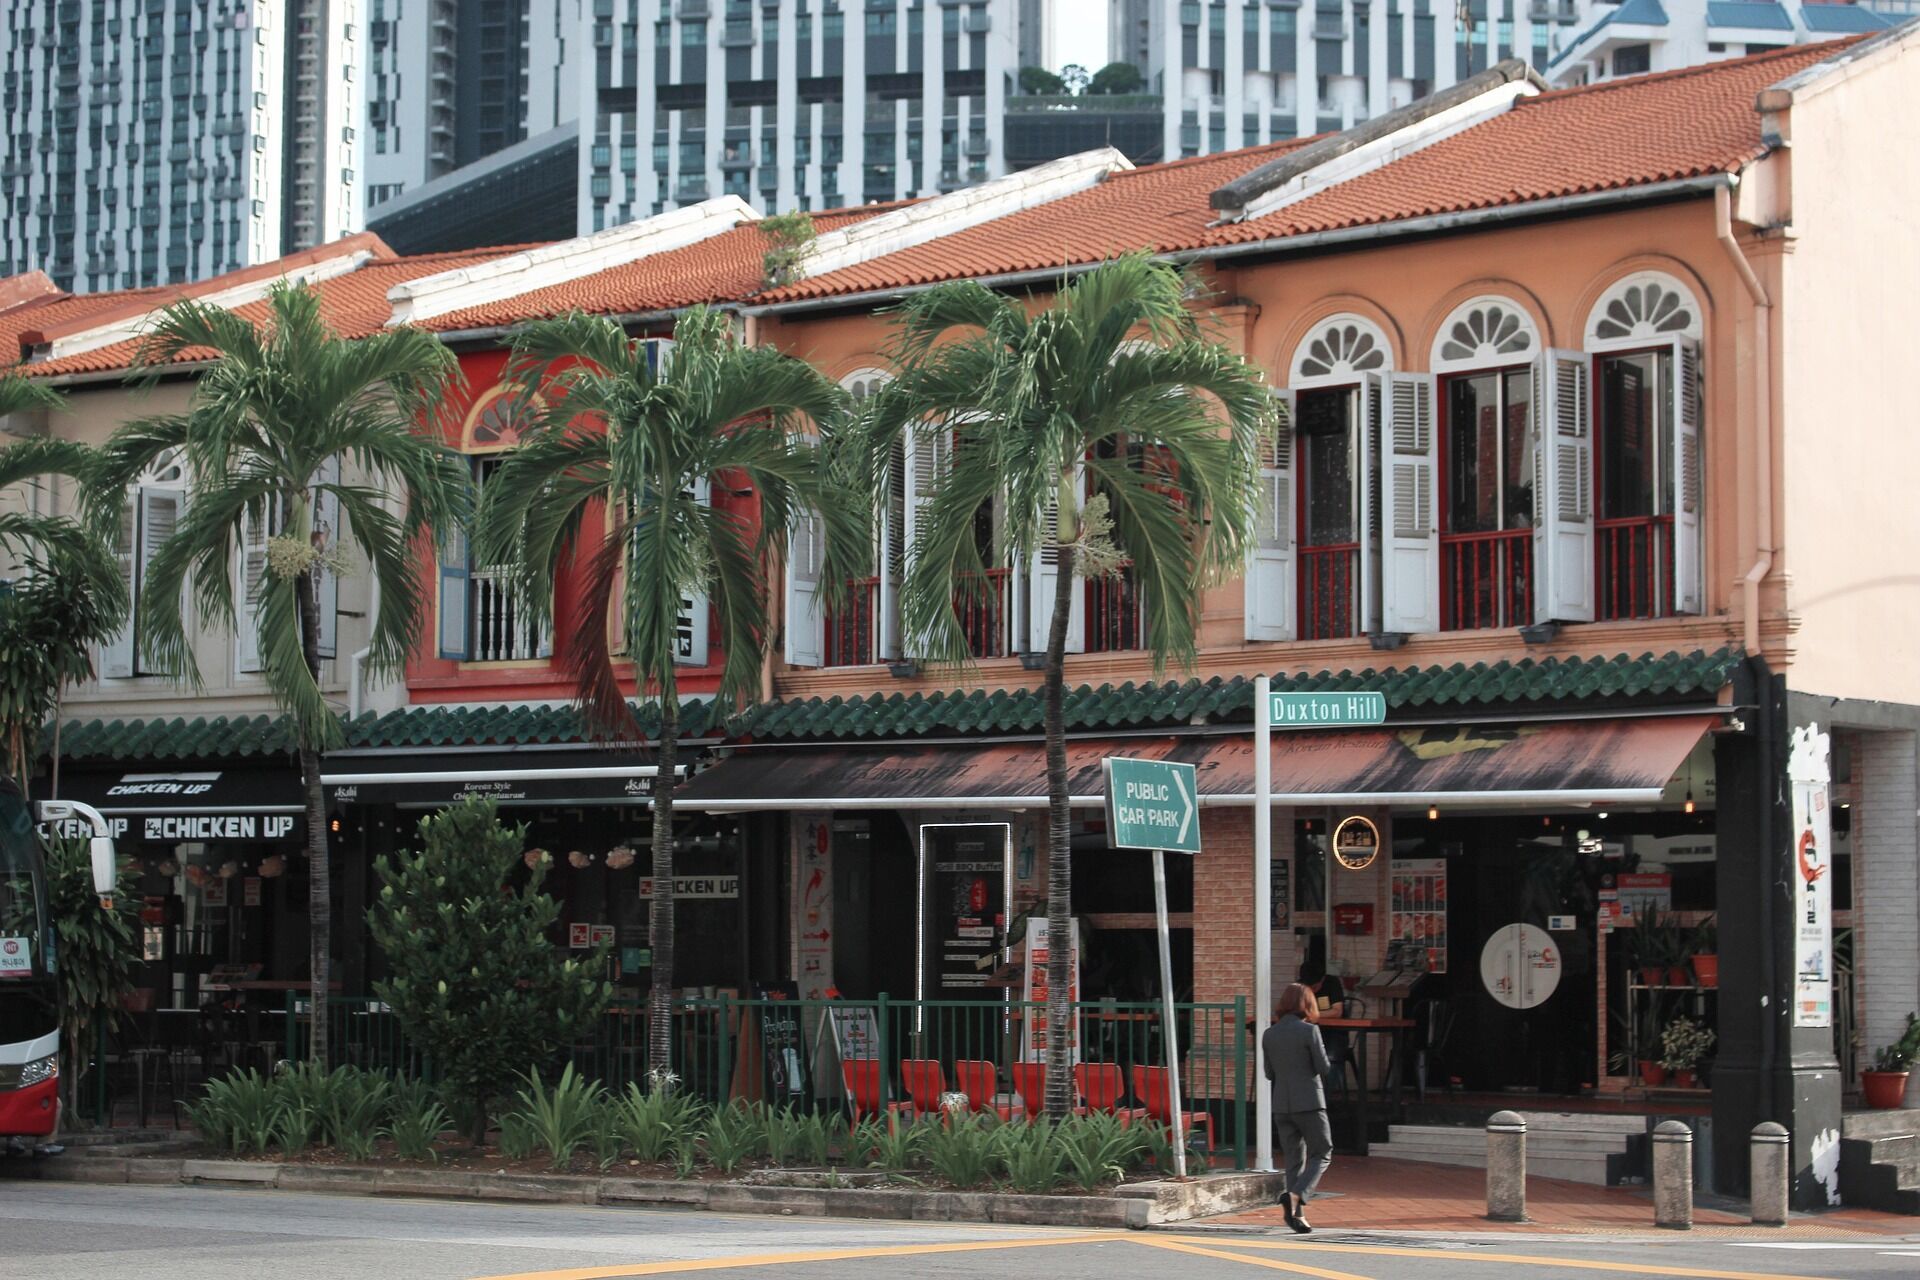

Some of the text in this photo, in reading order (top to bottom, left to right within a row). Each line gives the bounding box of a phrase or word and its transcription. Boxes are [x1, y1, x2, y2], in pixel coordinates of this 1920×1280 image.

[1274, 697, 1377, 720] Duxton Hill
[106, 783, 212, 795] CHICKEN UP
[464, 782, 512, 792] Korean Style
[624, 778, 650, 790] Asahi
[334, 786, 357, 797] Asahi
[1126, 782, 1169, 802] PUBLIC
[1119, 807, 1180, 828] CAR PARK
[163, 816, 293, 838] CHICKEN UP
[955, 862, 973, 871] BBQ
[975, 862, 1002, 871] Buffet
[672, 880, 714, 893] ICKEN
